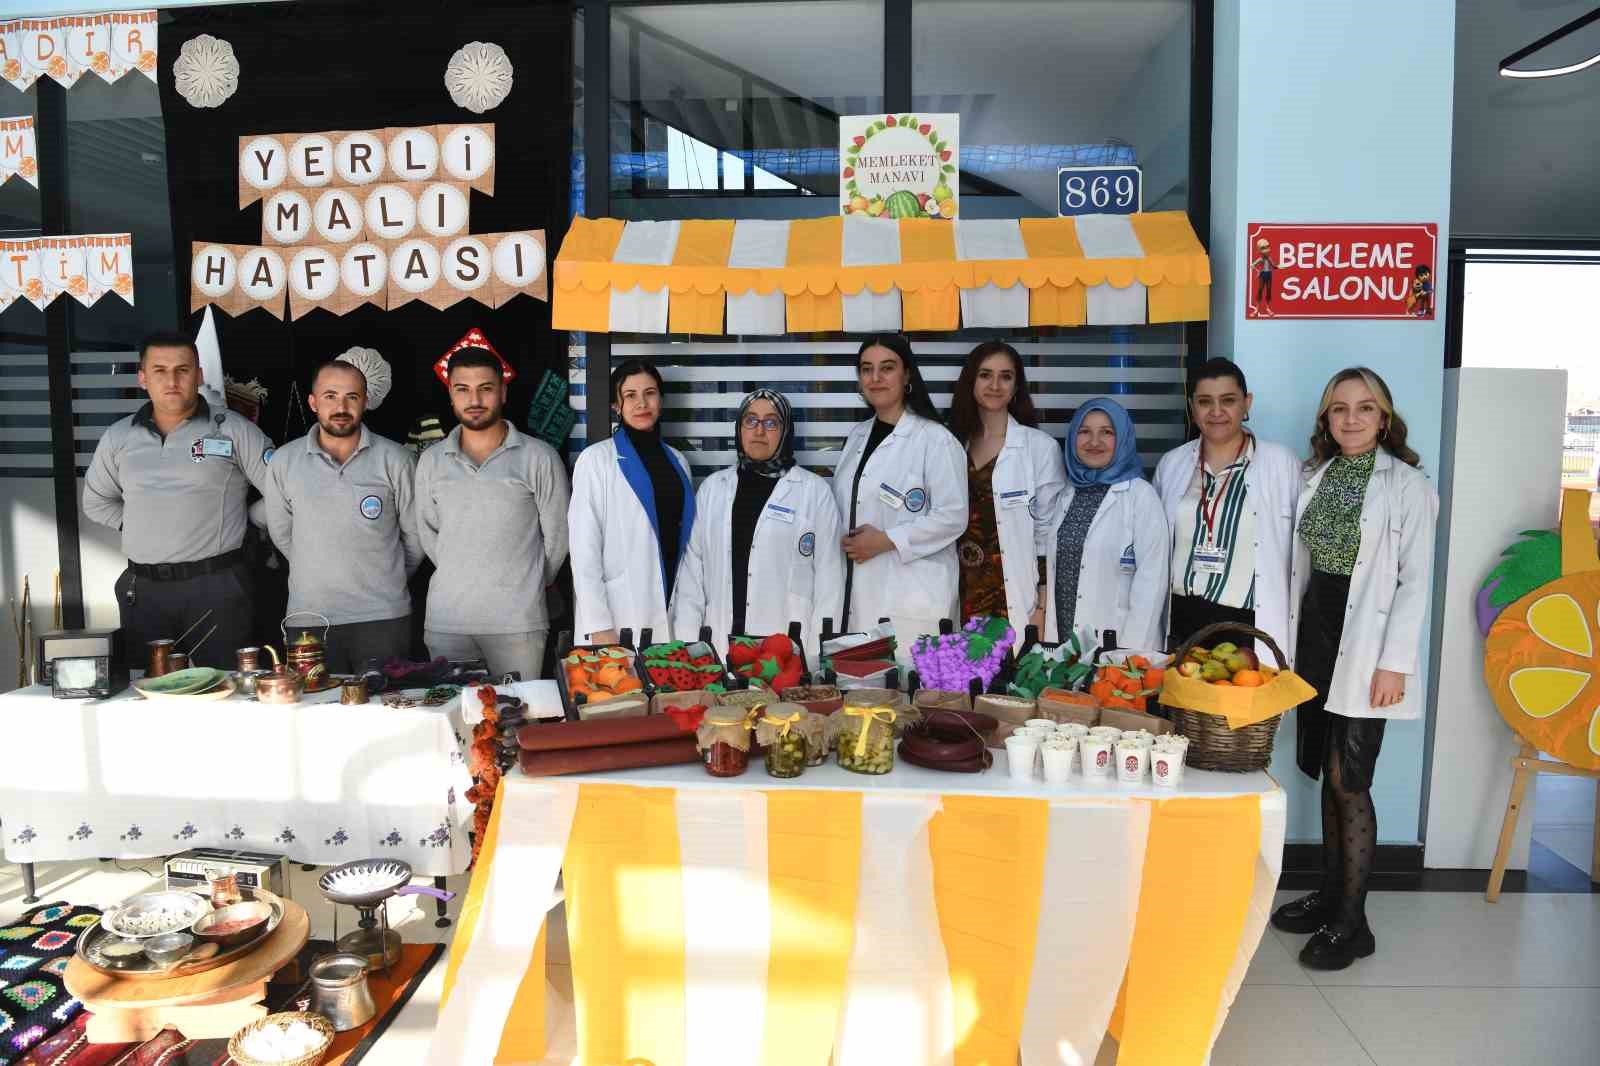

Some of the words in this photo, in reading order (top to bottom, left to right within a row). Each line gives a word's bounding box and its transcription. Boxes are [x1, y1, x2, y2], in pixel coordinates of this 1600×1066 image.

[254, 135, 471, 181] YERLİ
[857, 154, 935, 169] MEMLEKET
[869, 170, 925, 185] MANAVI
[1065, 175, 1134, 208] 869
[276, 193, 445, 231] MALI
[205, 243, 523, 290] HAFTASI
[1278, 242, 1414, 269] BEKLEME
[1280, 275, 1409, 301] SALONU
